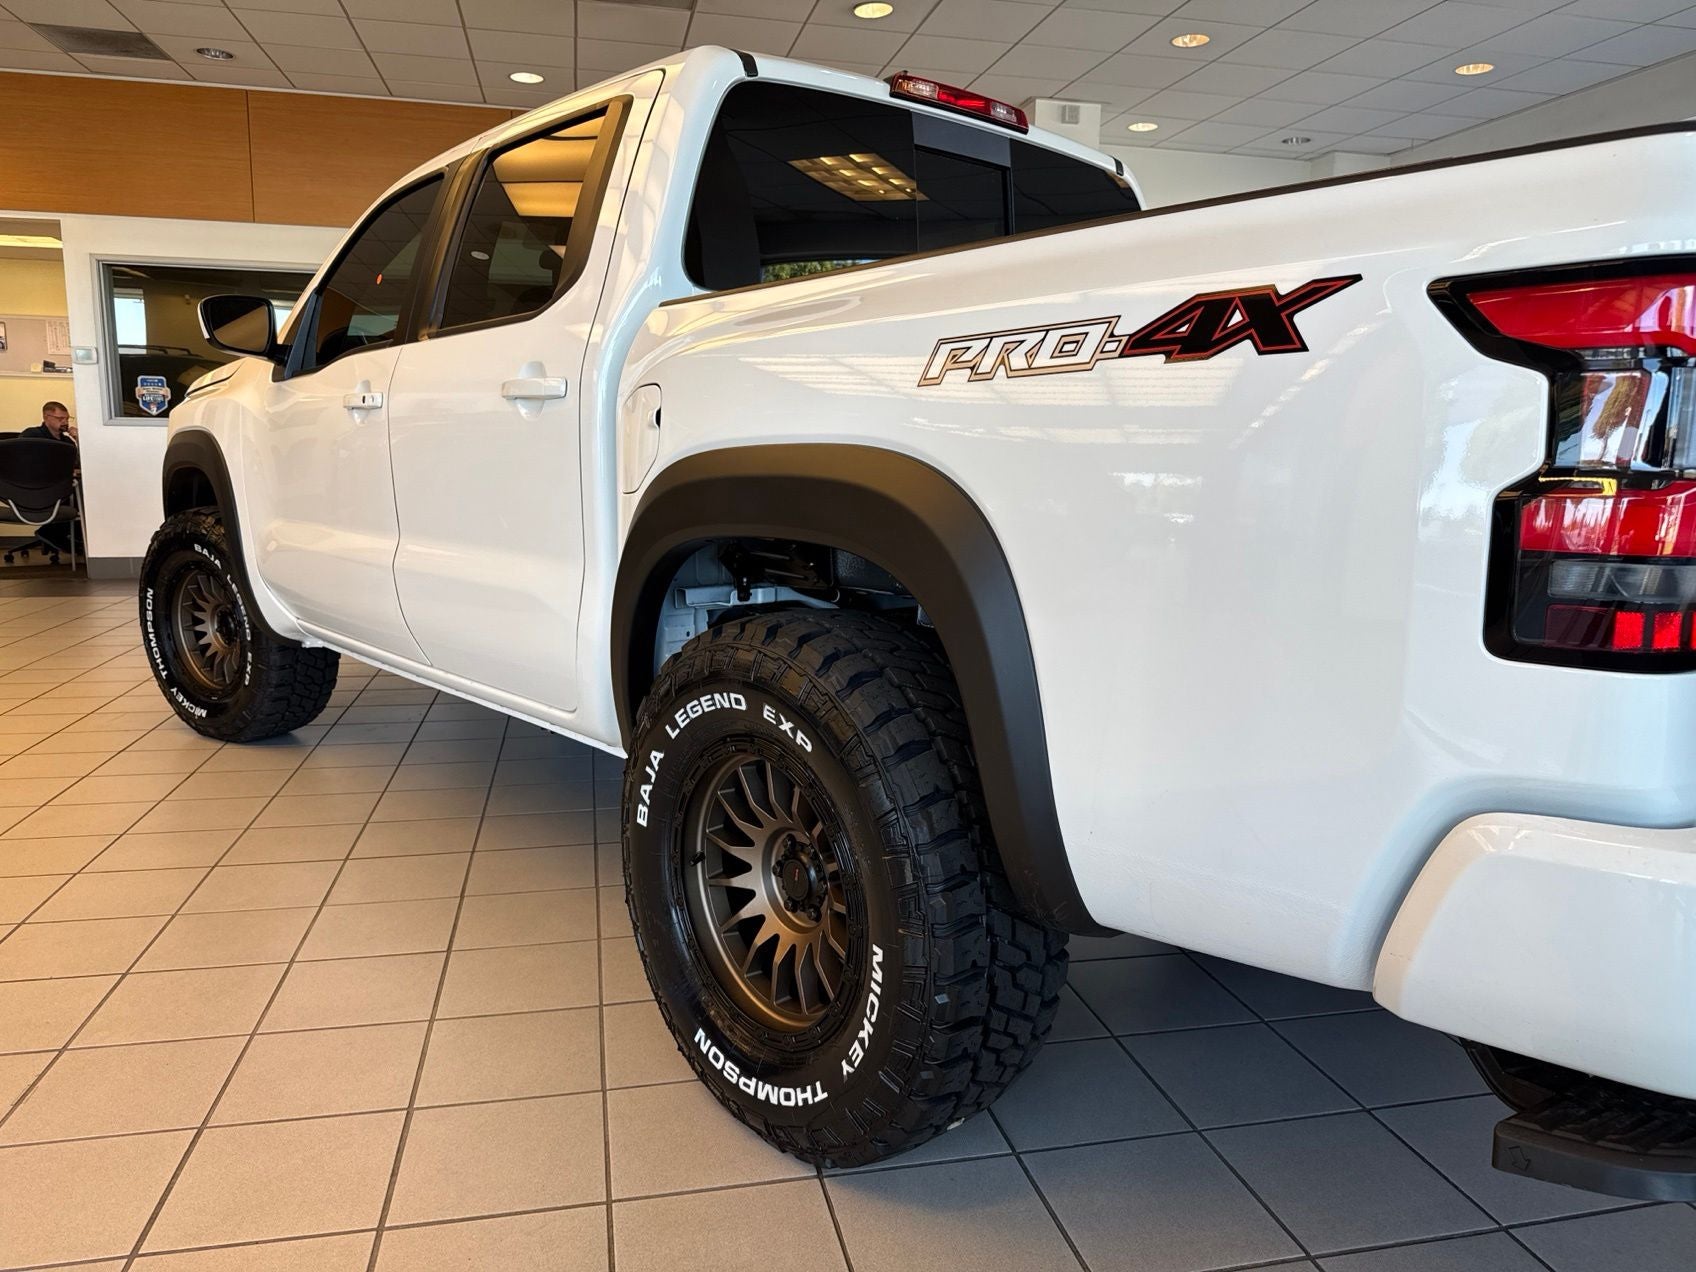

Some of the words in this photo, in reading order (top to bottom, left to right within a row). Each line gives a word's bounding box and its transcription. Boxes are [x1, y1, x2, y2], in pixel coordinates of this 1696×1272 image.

[917, 273, 1363, 387] PRO-4X
[145, 587, 168, 680] THOMPSON
[193, 543, 222, 570] BAJA
[226, 573, 252, 641] LEGEND
[244, 651, 253, 686] EXP
[170, 686, 208, 719] MICKEY
[636, 750, 665, 827] BAJA
[665, 692, 747, 740] LEGEND
[762, 703, 813, 752] EXP
[693, 1027, 829, 1107] THOMPSON
[841, 943, 884, 1083] MICKEY
